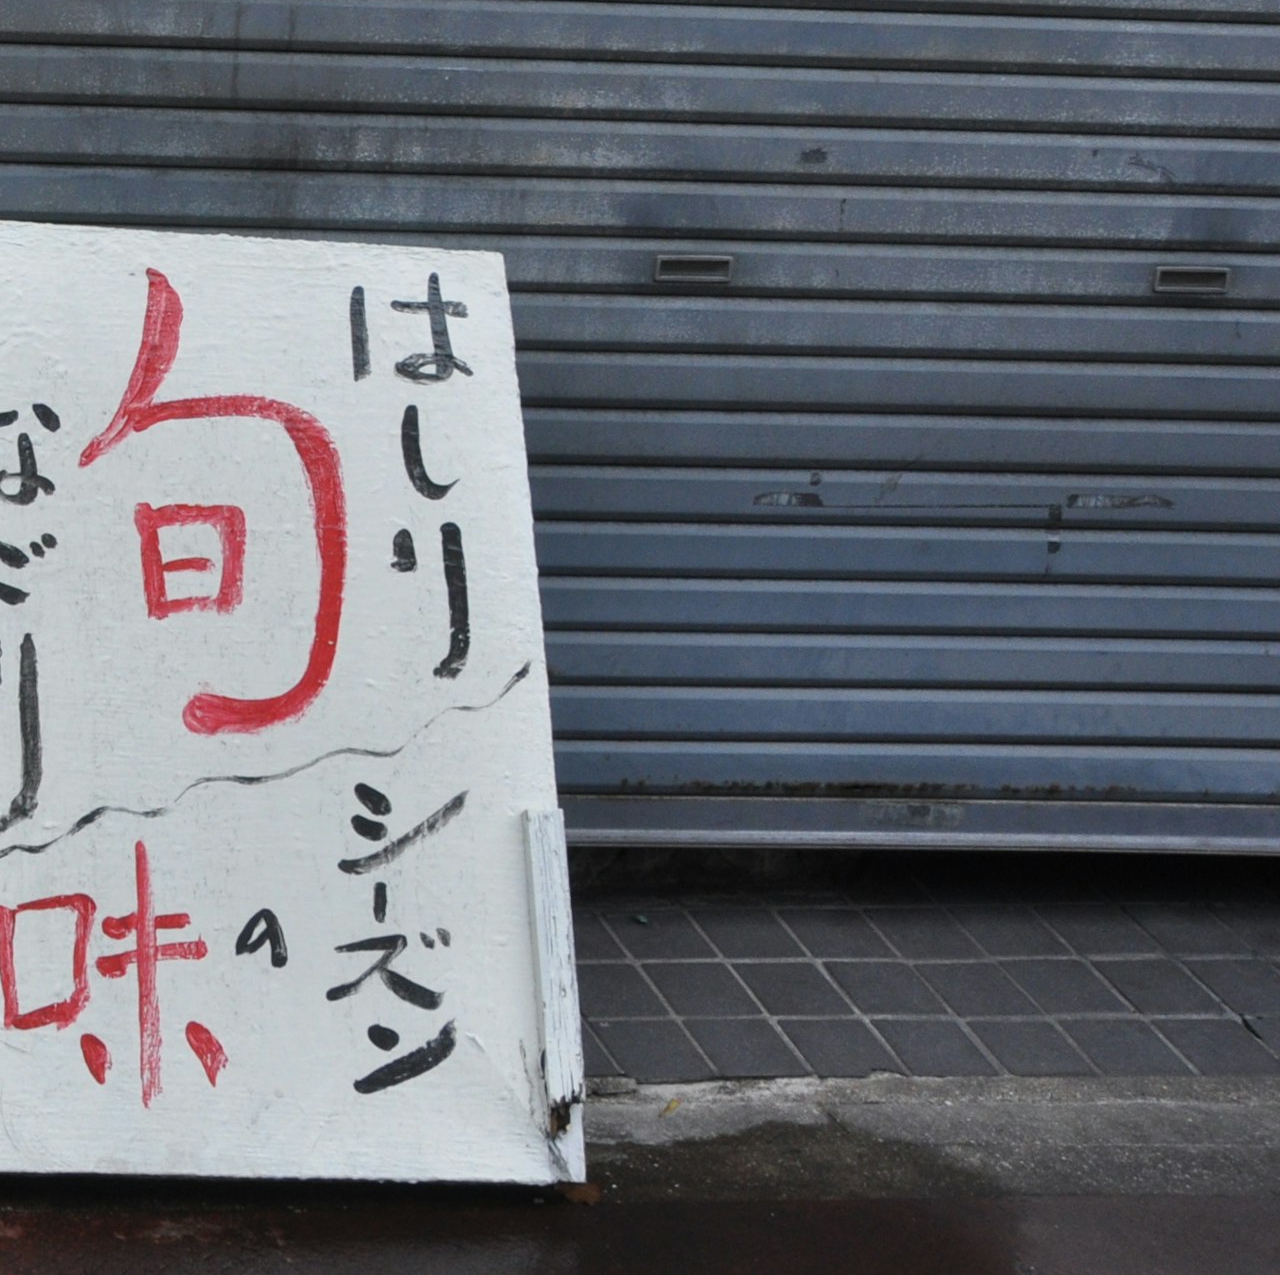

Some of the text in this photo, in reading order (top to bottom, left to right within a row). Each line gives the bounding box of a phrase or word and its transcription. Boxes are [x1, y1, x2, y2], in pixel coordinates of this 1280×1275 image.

[78, 267, 348, 735] 旬
[350, 272, 473, 679] はしり
[235, 908, 288, 968] の
[326, 783, 469, 1094] シーズン
